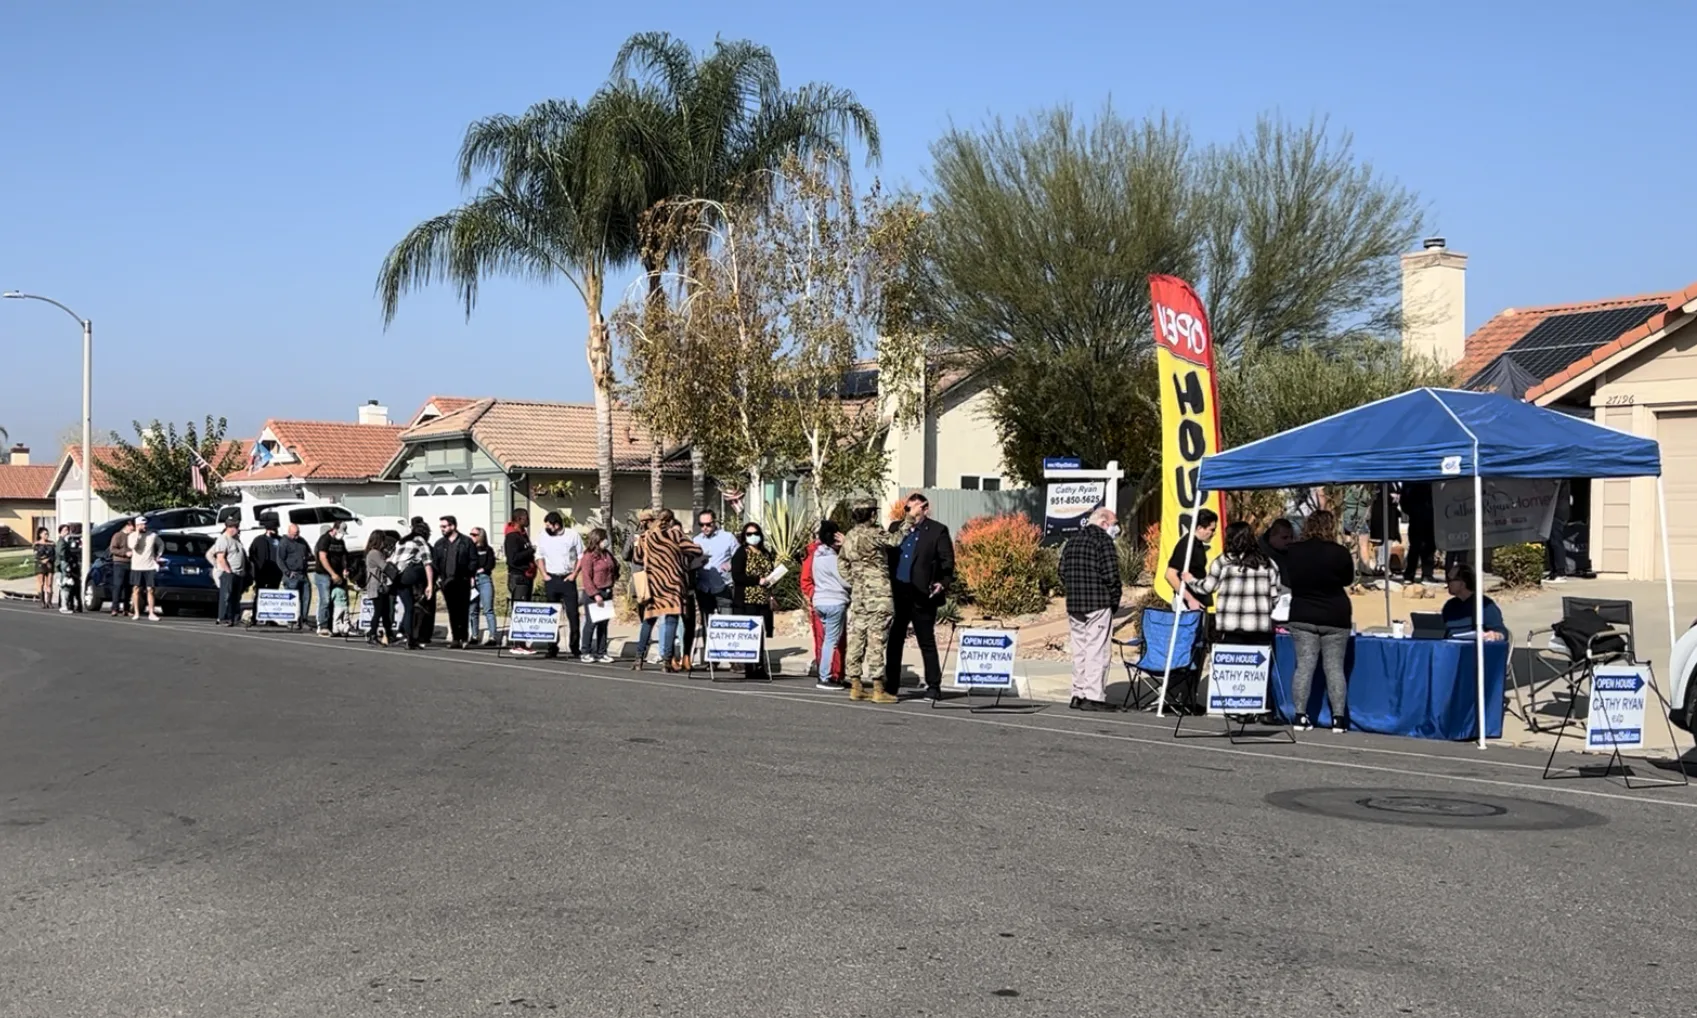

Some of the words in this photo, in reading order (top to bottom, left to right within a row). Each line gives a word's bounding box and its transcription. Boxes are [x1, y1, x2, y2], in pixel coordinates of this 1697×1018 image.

[1605, 394, 1635, 405] 27196
[1055, 486, 1076, 495] Cathy
[1078, 485, 1098, 494] Ryan
[1050, 495, 1100, 505] 951-850-5625
[709, 632, 736, 640] CATHY
[737, 632, 759, 640] RYAN
[963, 637, 982, 645] OPEN
[982, 638, 1005, 646] HOUSE
[960, 650, 989, 660] CATHY
[990, 651, 1013, 661] RYAN
[1215, 653, 1235, 663] OPEN
[1235, 653, 1259, 664] HOUSE
[1212, 669, 1242, 680] CATHY
[1243, 670, 1266, 681] RYAN
[1596, 678, 1615, 689] OPEN
[1615, 678, 1637, 689] HOUSE
[1592, 697, 1621, 711] CATHY
[1621, 698, 1644, 710] RYAN
